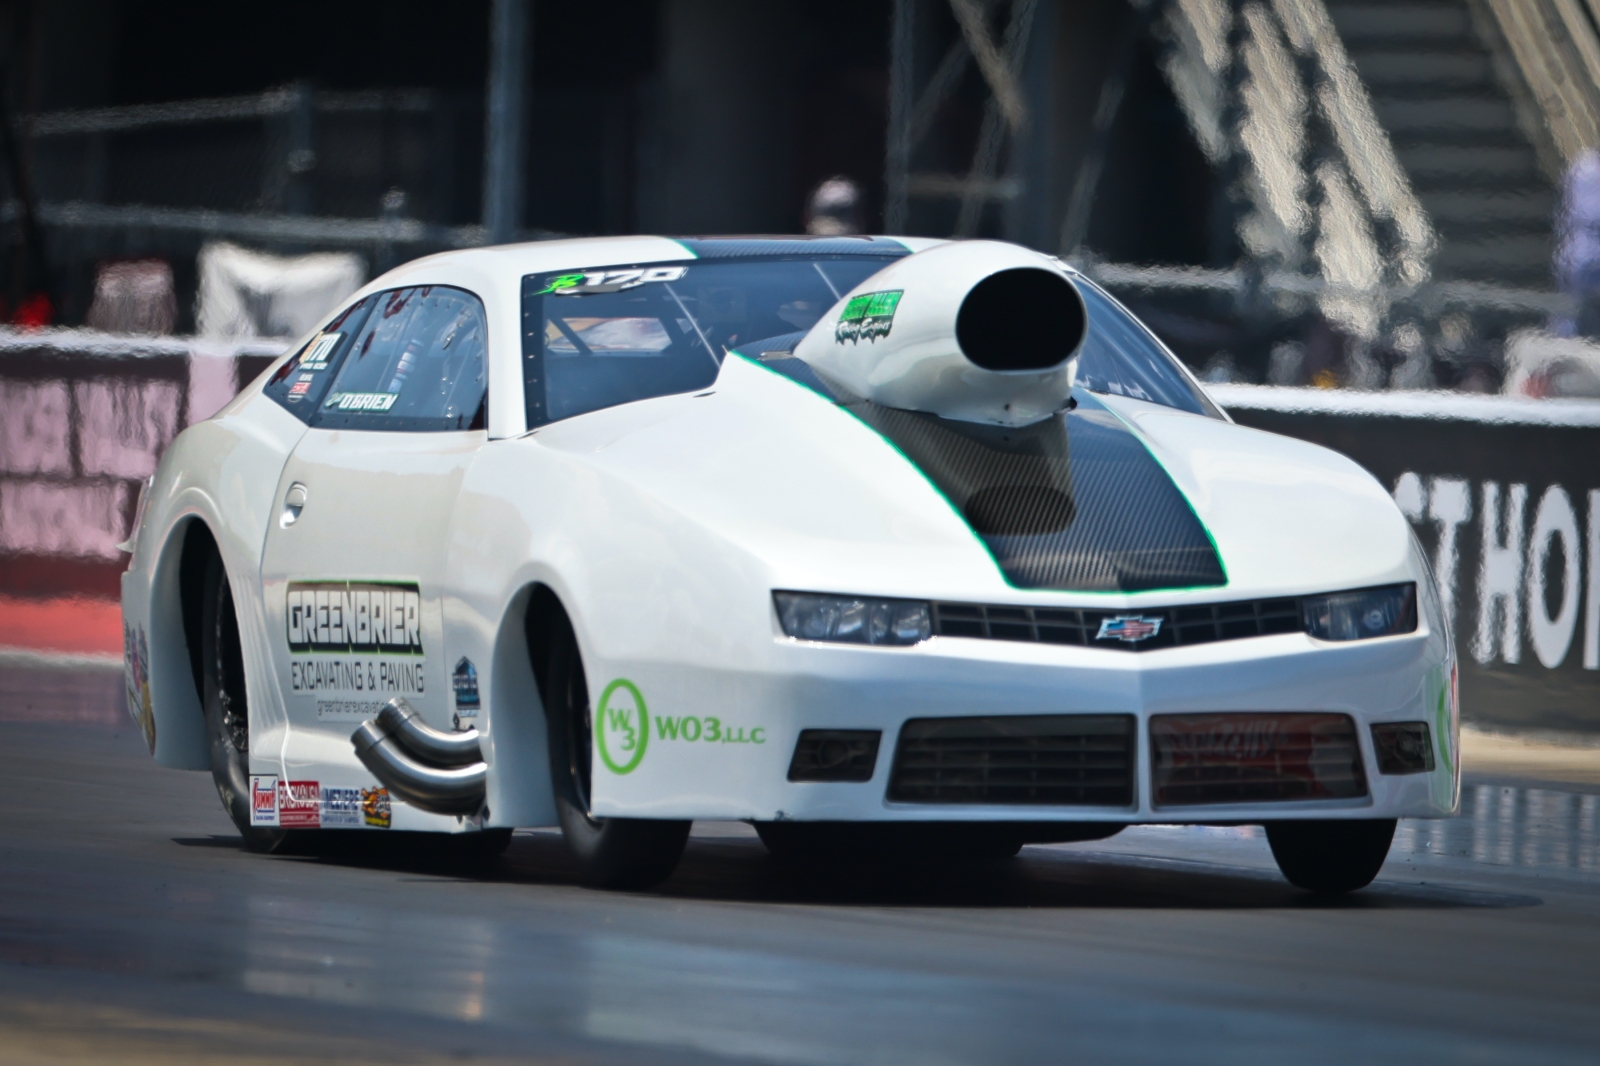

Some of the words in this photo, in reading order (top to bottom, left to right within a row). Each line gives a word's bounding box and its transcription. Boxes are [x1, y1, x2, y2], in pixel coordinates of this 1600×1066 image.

[288, 590, 420, 646] GREENBRIER
[291, 661, 364, 691] EXCAVATING
[367, 662, 377, 692] &
[379, 663, 425, 694] PAVING
